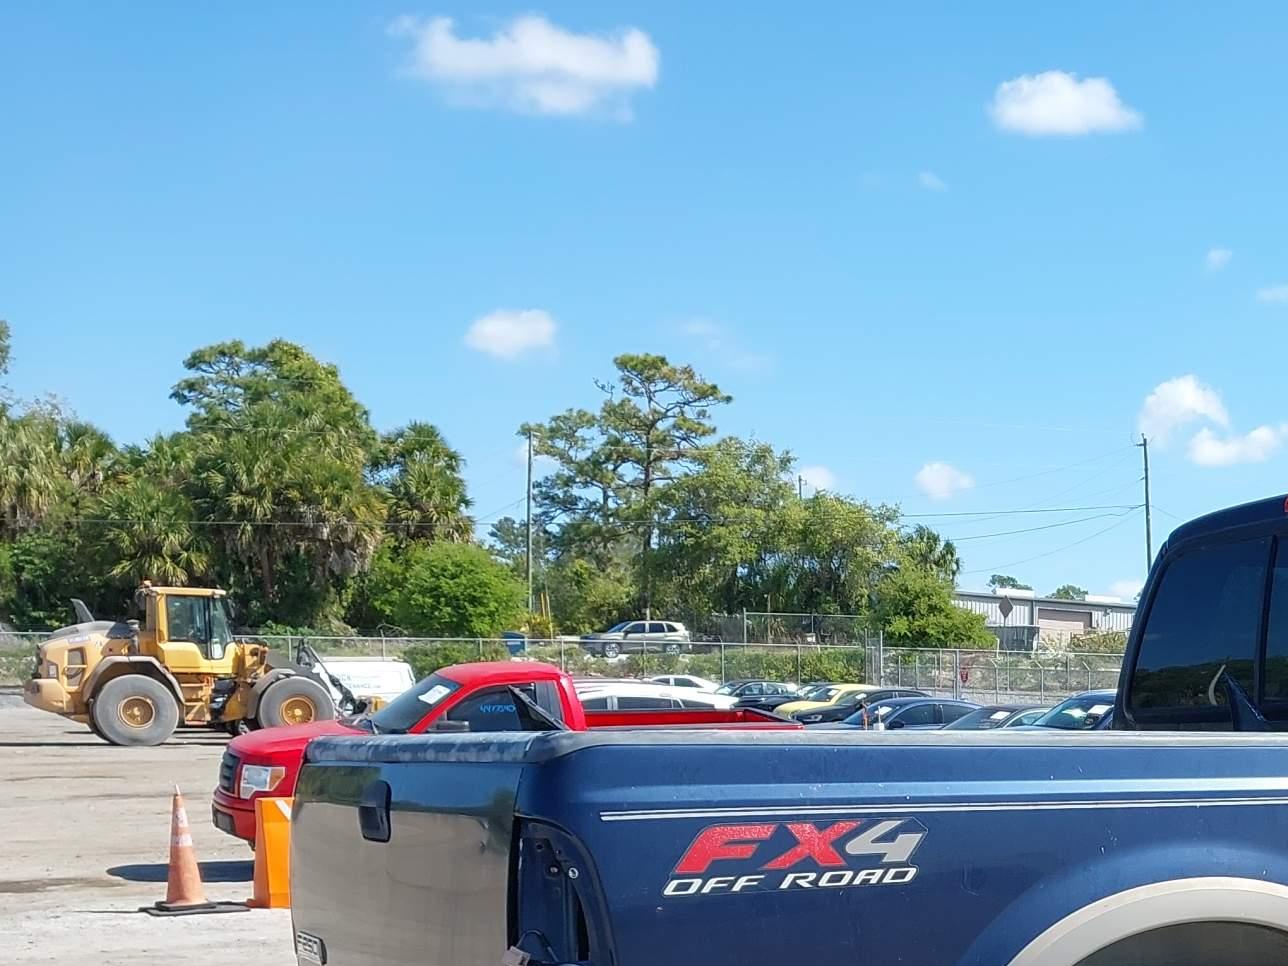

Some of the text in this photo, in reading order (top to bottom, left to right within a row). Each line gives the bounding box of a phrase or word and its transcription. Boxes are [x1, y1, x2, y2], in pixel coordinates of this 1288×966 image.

[675, 819, 924, 875] FX4
[663, 866, 917, 896] OFF ROAD
